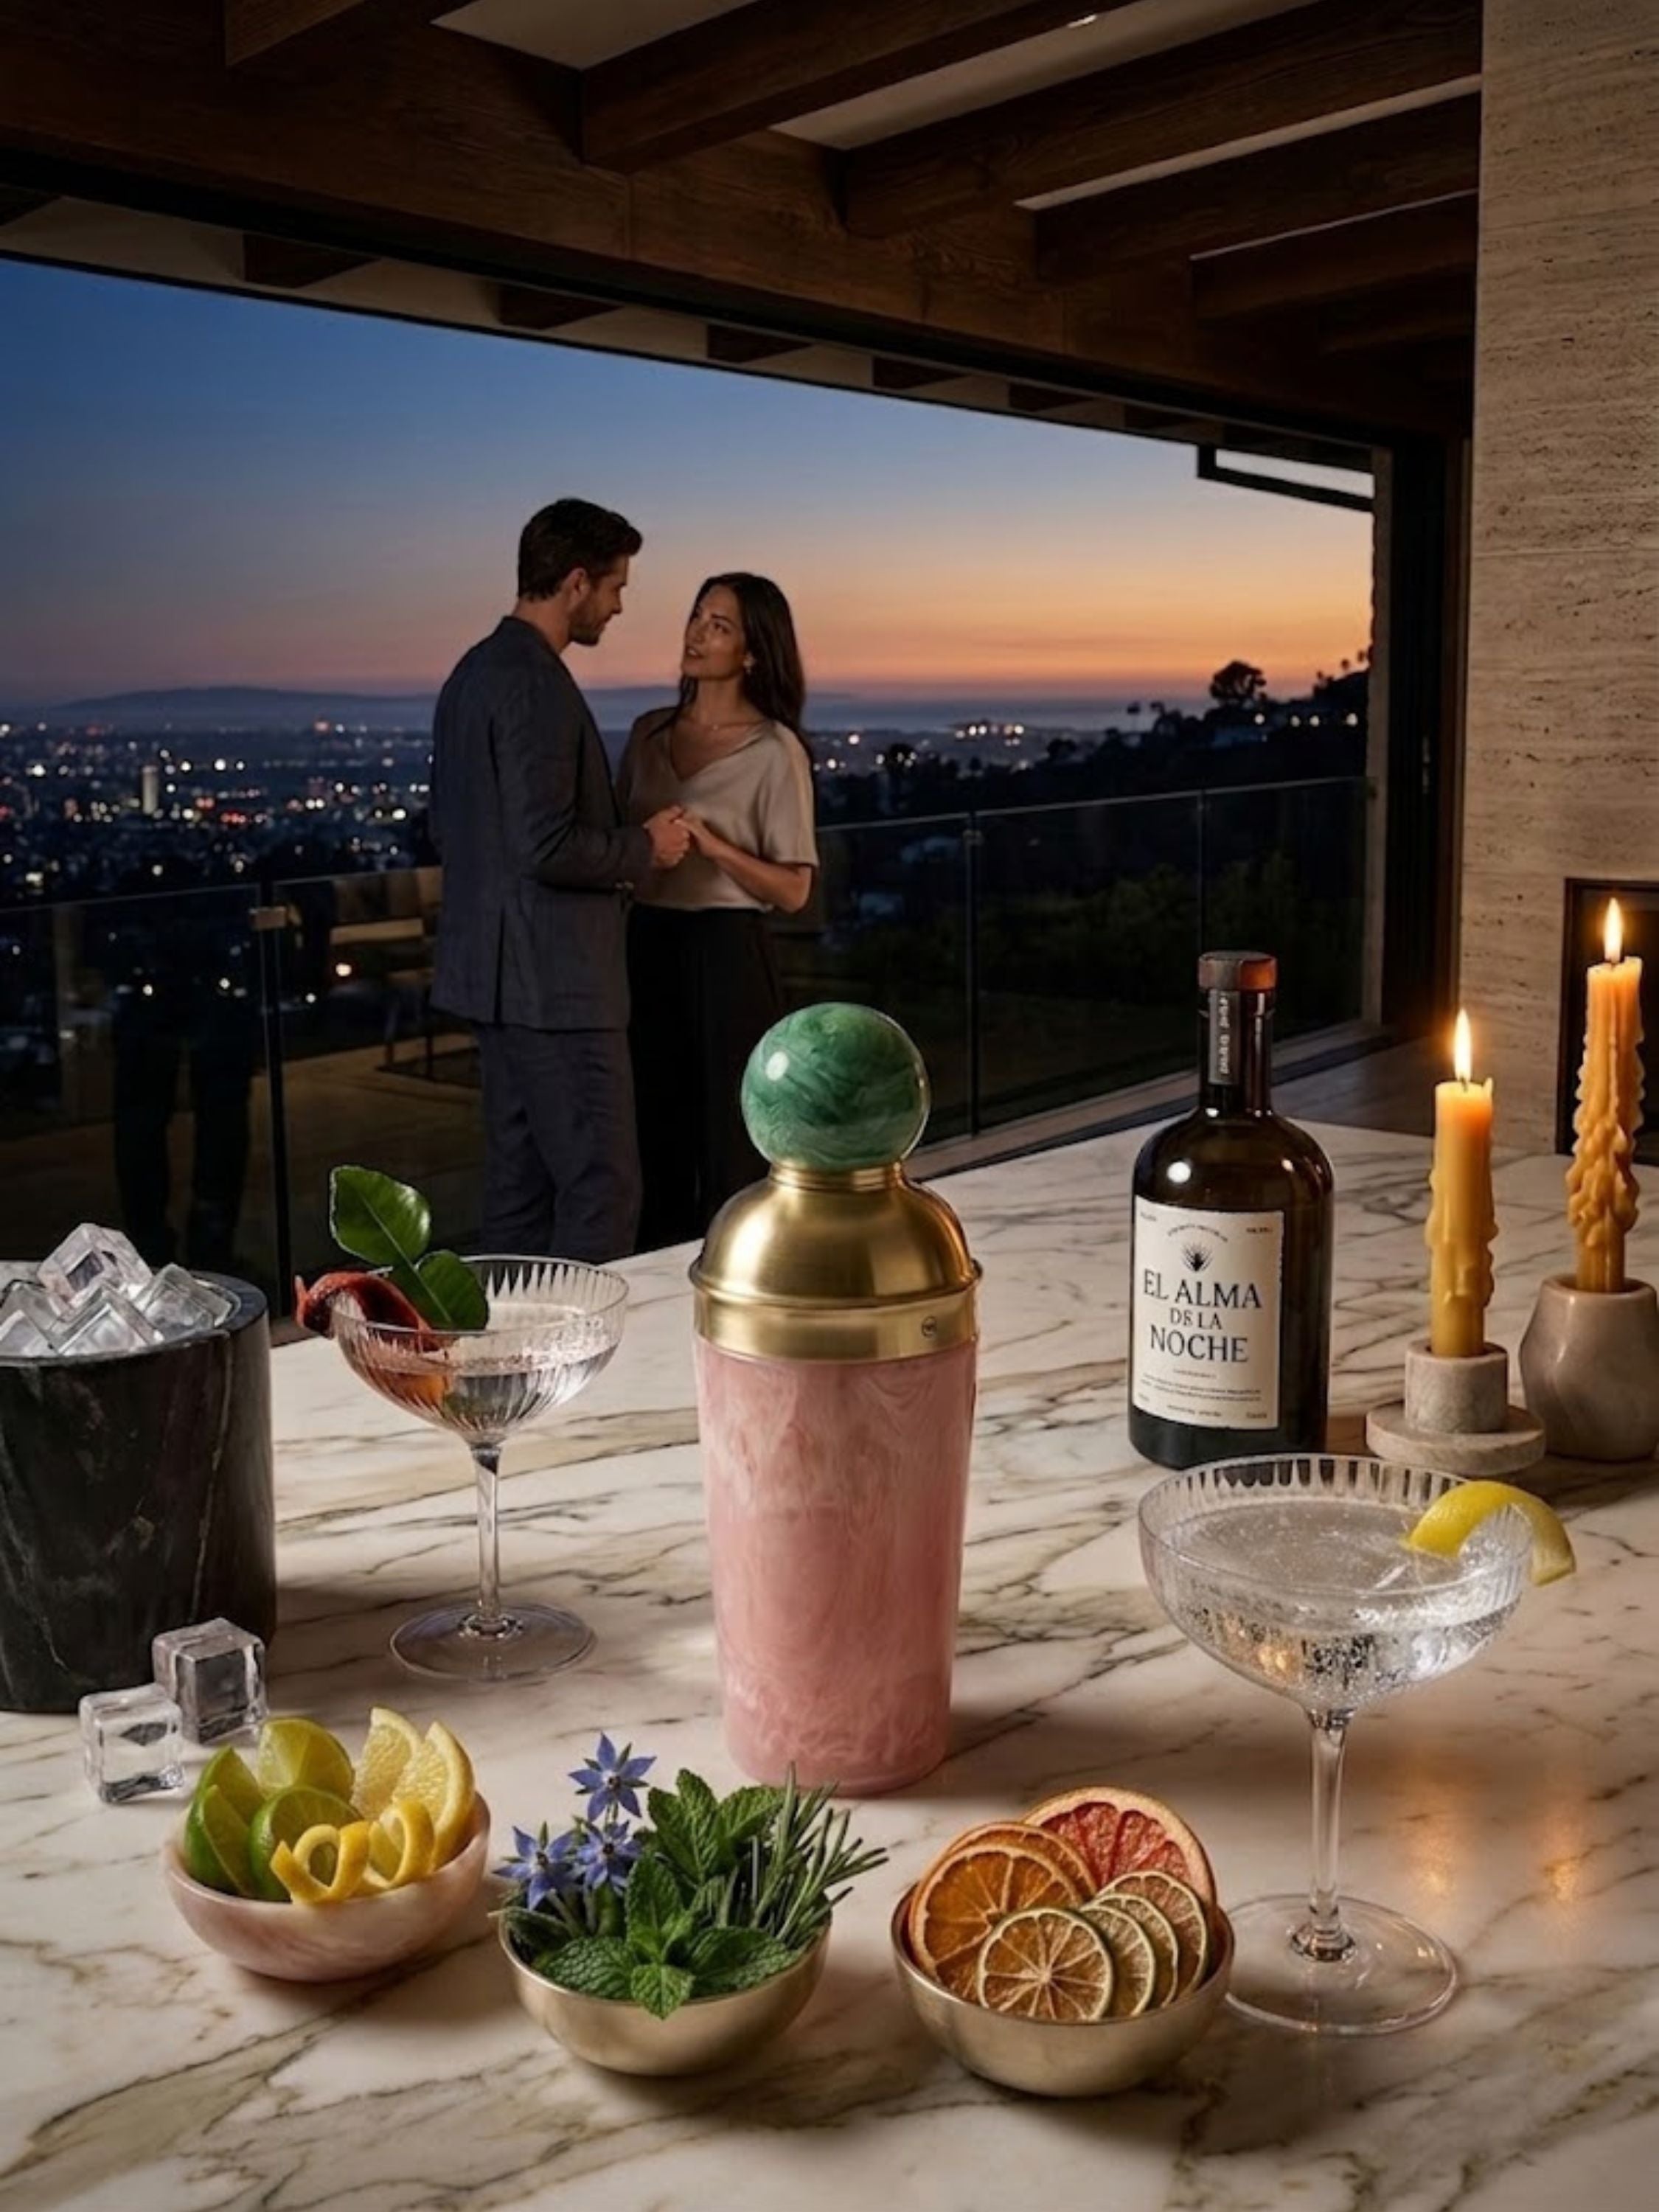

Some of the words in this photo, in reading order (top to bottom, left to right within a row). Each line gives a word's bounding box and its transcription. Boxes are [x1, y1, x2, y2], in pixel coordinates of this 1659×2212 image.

[1144, 1268, 1169, 1299] EL
[1175, 1279, 1262, 1308] ALMA
[1198, 1312, 1222, 1329] LA
[1151, 1324, 1249, 1362] NOCHE
